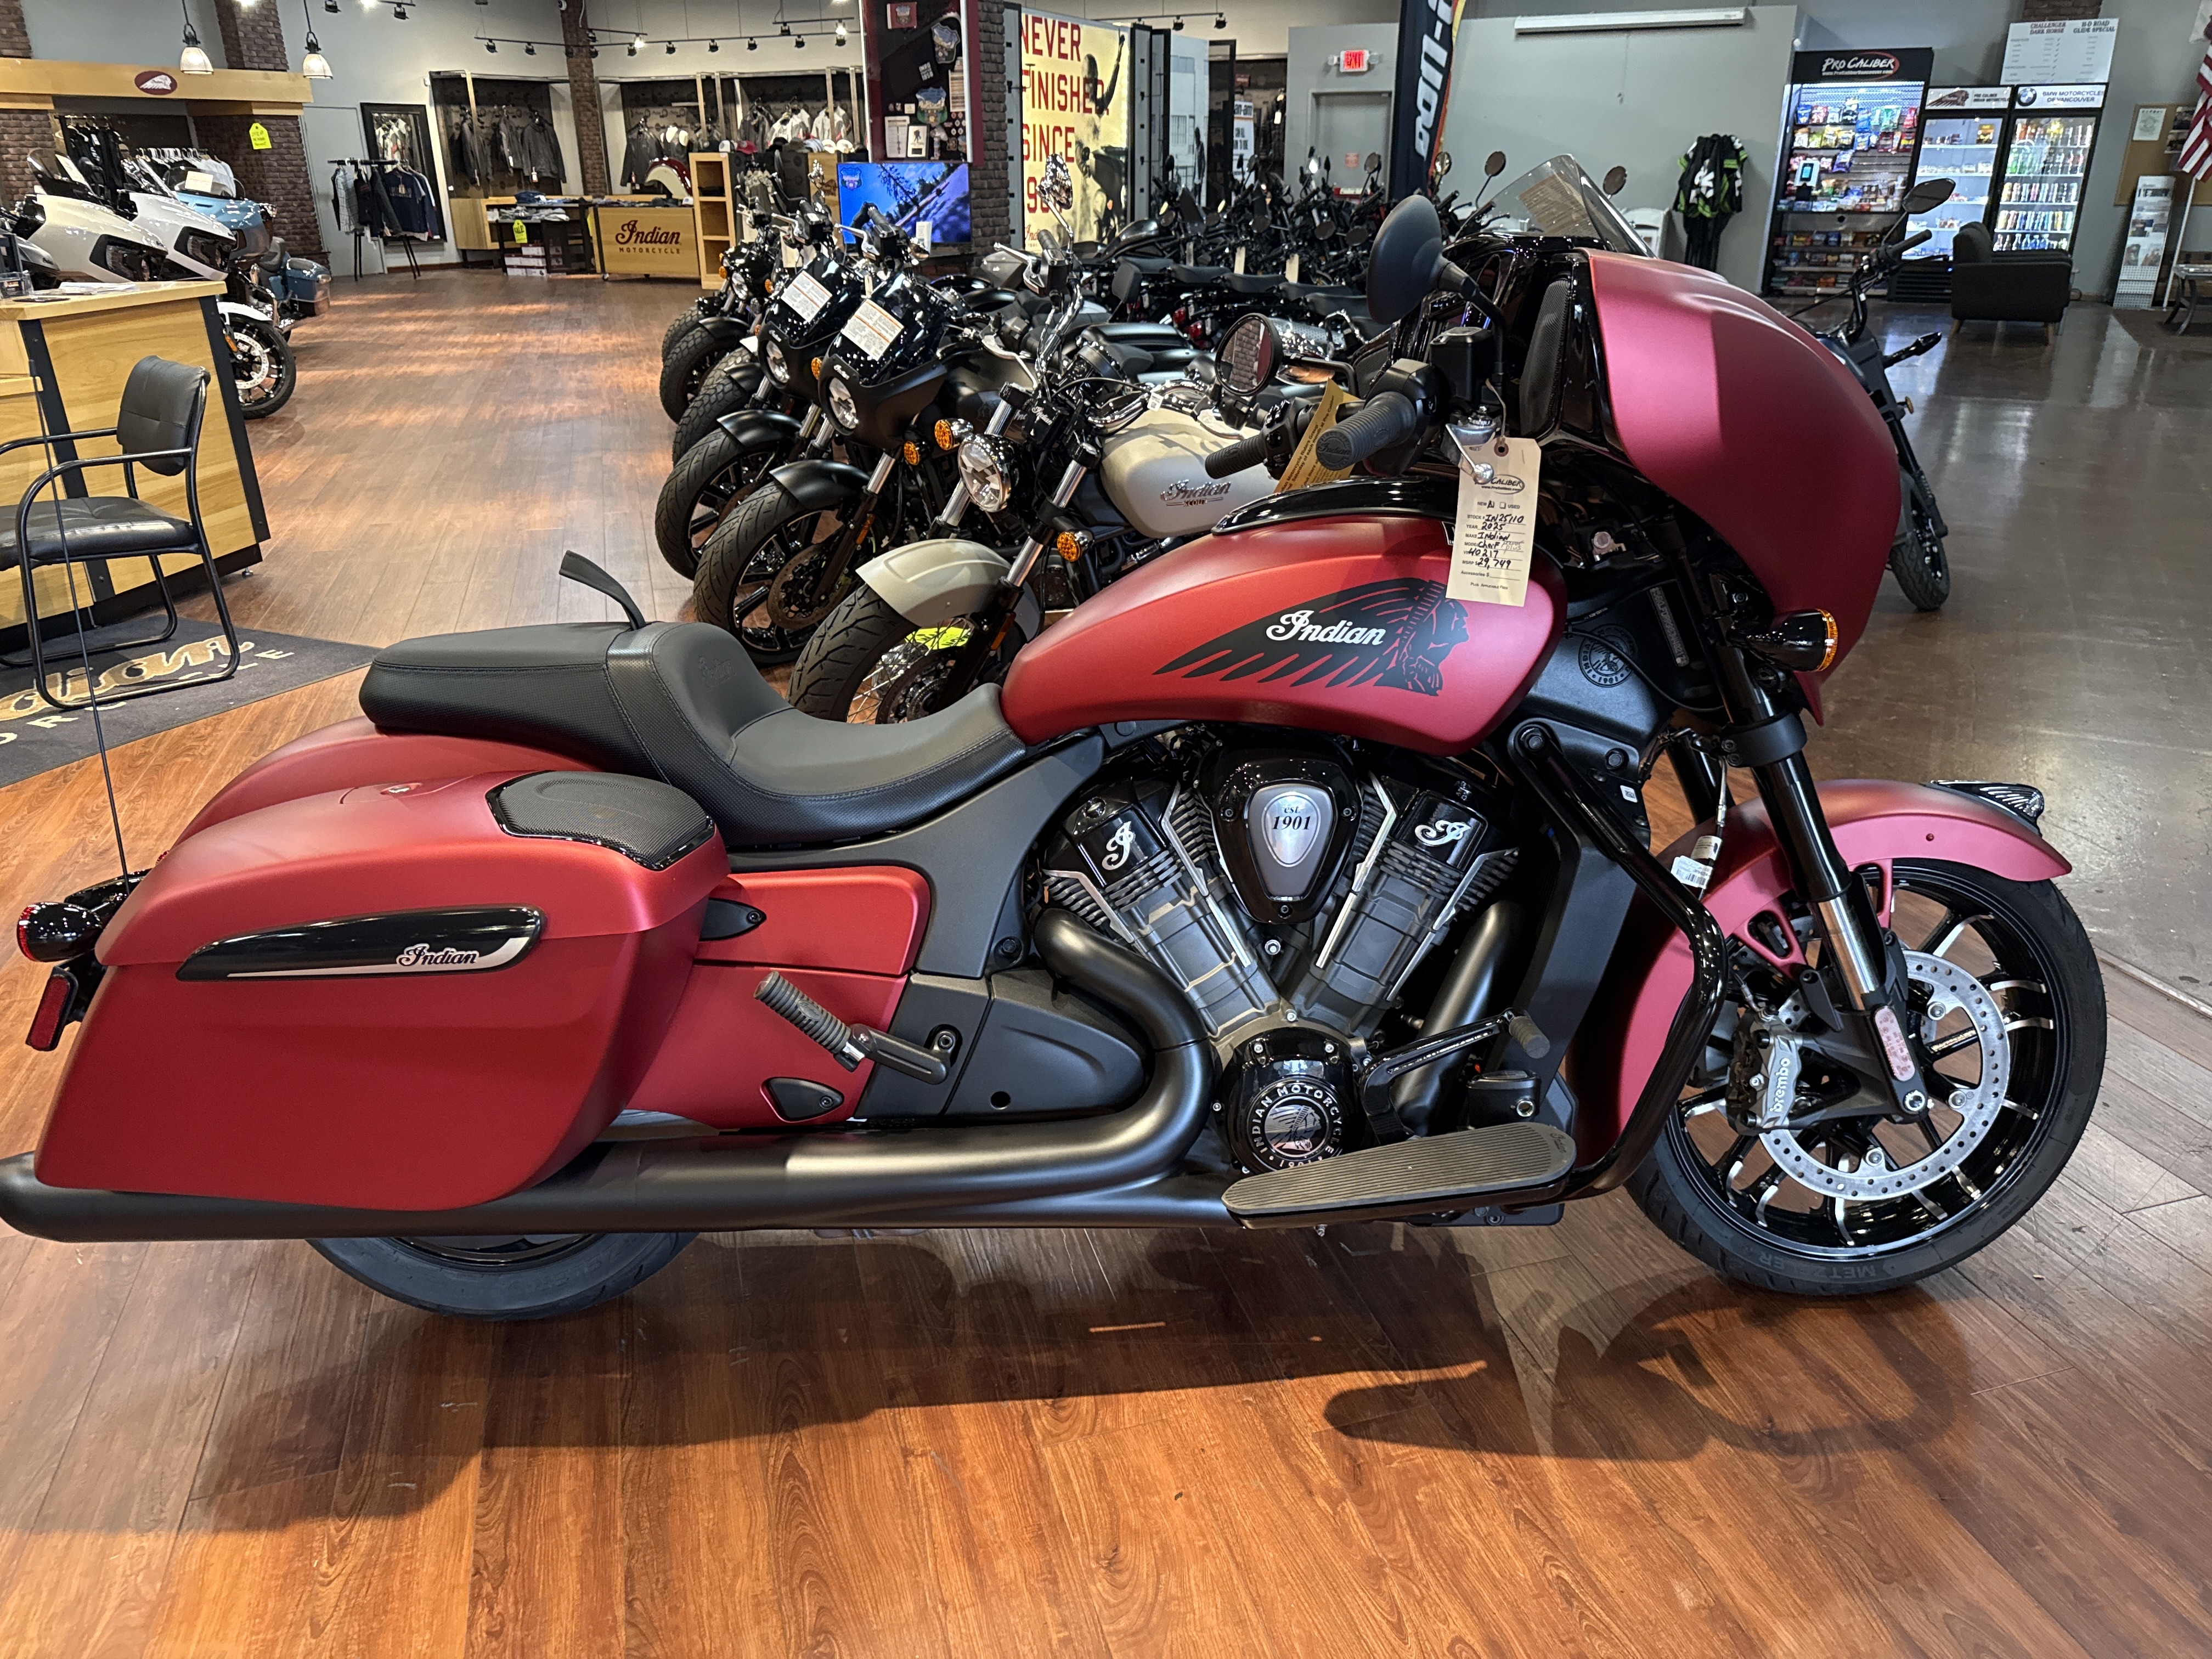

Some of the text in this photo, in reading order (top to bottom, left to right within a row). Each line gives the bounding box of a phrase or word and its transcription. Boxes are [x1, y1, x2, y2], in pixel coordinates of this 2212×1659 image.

[1022, 14, 1081, 62] NEVER
[1345, 50, 1365, 69] EXIT
[1821, 57, 1895, 72] PRO CALIBER
[1023, 123, 1075, 163] SINCE
[616, 220, 680, 245] Indian
[1288, 457, 1302, 481] Motorcycle
[1301, 439, 1311, 456] Riders
[1309, 424, 1319, 439] Group
[1291, 461, 1306, 482] Saturday
[1491, 477, 1522, 488] CALIBER
[1160, 479, 1232, 501] Indian
[1481, 521, 1506, 531] 2025
[1469, 547, 1499, 559] 40217
[1477, 557, 1511, 570] 29,749
[1266, 610, 1386, 645] Indian
[1271, 815, 1311, 830] 1901
[397, 944, 478, 967] Indian
[1769, 1058, 1791, 1113] brembo
[1252, 1084, 1342, 1154] INDIAN MOTORCYCLE
